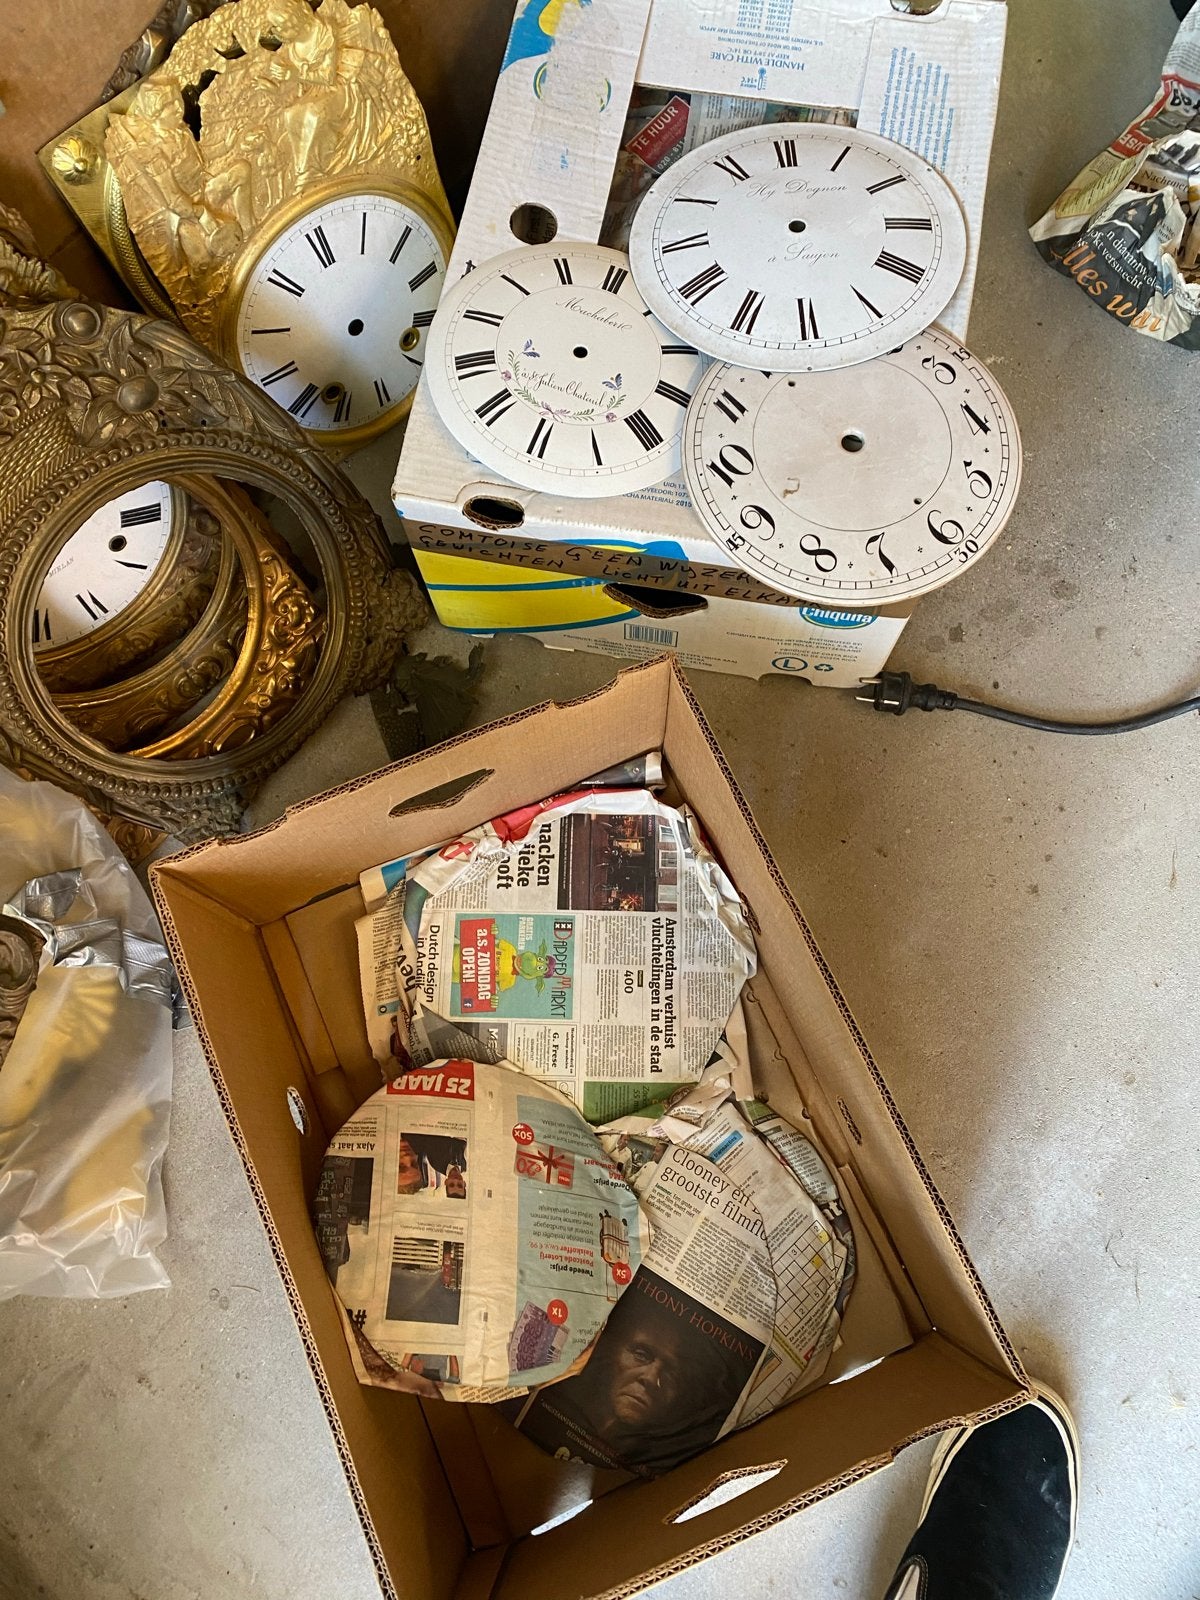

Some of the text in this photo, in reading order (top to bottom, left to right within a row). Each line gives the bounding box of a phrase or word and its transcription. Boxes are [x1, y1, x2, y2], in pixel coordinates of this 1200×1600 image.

[710, 51, 804, 70] HANDLE WITH CARE
[631, 134, 650, 152] TE
[645, 104, 679, 139] HUUR
[921, 355, 957, 385] 3
[951, 346, 971, 362] 15
[713, 388, 748, 424] 11
[959, 400, 991, 436] 4
[705, 443, 754, 488] 10
[963, 460, 992, 499] 5
[739, 504, 776, 541] 9
[927, 509, 964, 545] 6
[418, 521, 642, 572] COMTOISE GEEN
[418, 534, 564, 570] GEWICHTEN
[725, 532, 746, 553] 45
[799, 533, 837, 572] 8
[865, 531, 898, 577] 7
[953, 538, 979, 564] 30
[676, 579, 714, 593] UIT
[782, 658, 796, 669] L
[415, 937, 426, 947] in
[424, 924, 440, 1003] Dutch design
[461, 947, 475, 982] OPEN!
[476, 928, 490, 1000] a.s. ZONDAG
[623, 969, 633, 993] 400
[648, 917, 663, 1073] vluchtelingen in de stad
[664, 917, 676, 1049] Amsterdam verhuist
[551, 1032, 559, 1068] G. Frese
[391, 1073, 471, 1092] 25 JAAR
[336, 1139, 375, 1153] Ajax laat
[513, 1128, 532, 1140] 50x
[514, 1156, 543, 1177] €20
[592, 1177, 631, 1191] Derde prijs:
[671, 1147, 729, 1195] Clooney
[732, 1190, 750, 1206] en
[661, 1165, 721, 1208] grootste
[538, 1250, 594, 1266] Postcode Loterij
[559, 1245, 594, 1256] Reiskoffer
[548, 1262, 593, 1276] Tweede prijs:
[615, 1267, 627, 1278] 5x
[550, 1306, 563, 1318] 1x
[636, 1277, 689, 1317] THONY
[690, 1314, 756, 1361] HOPKINS
